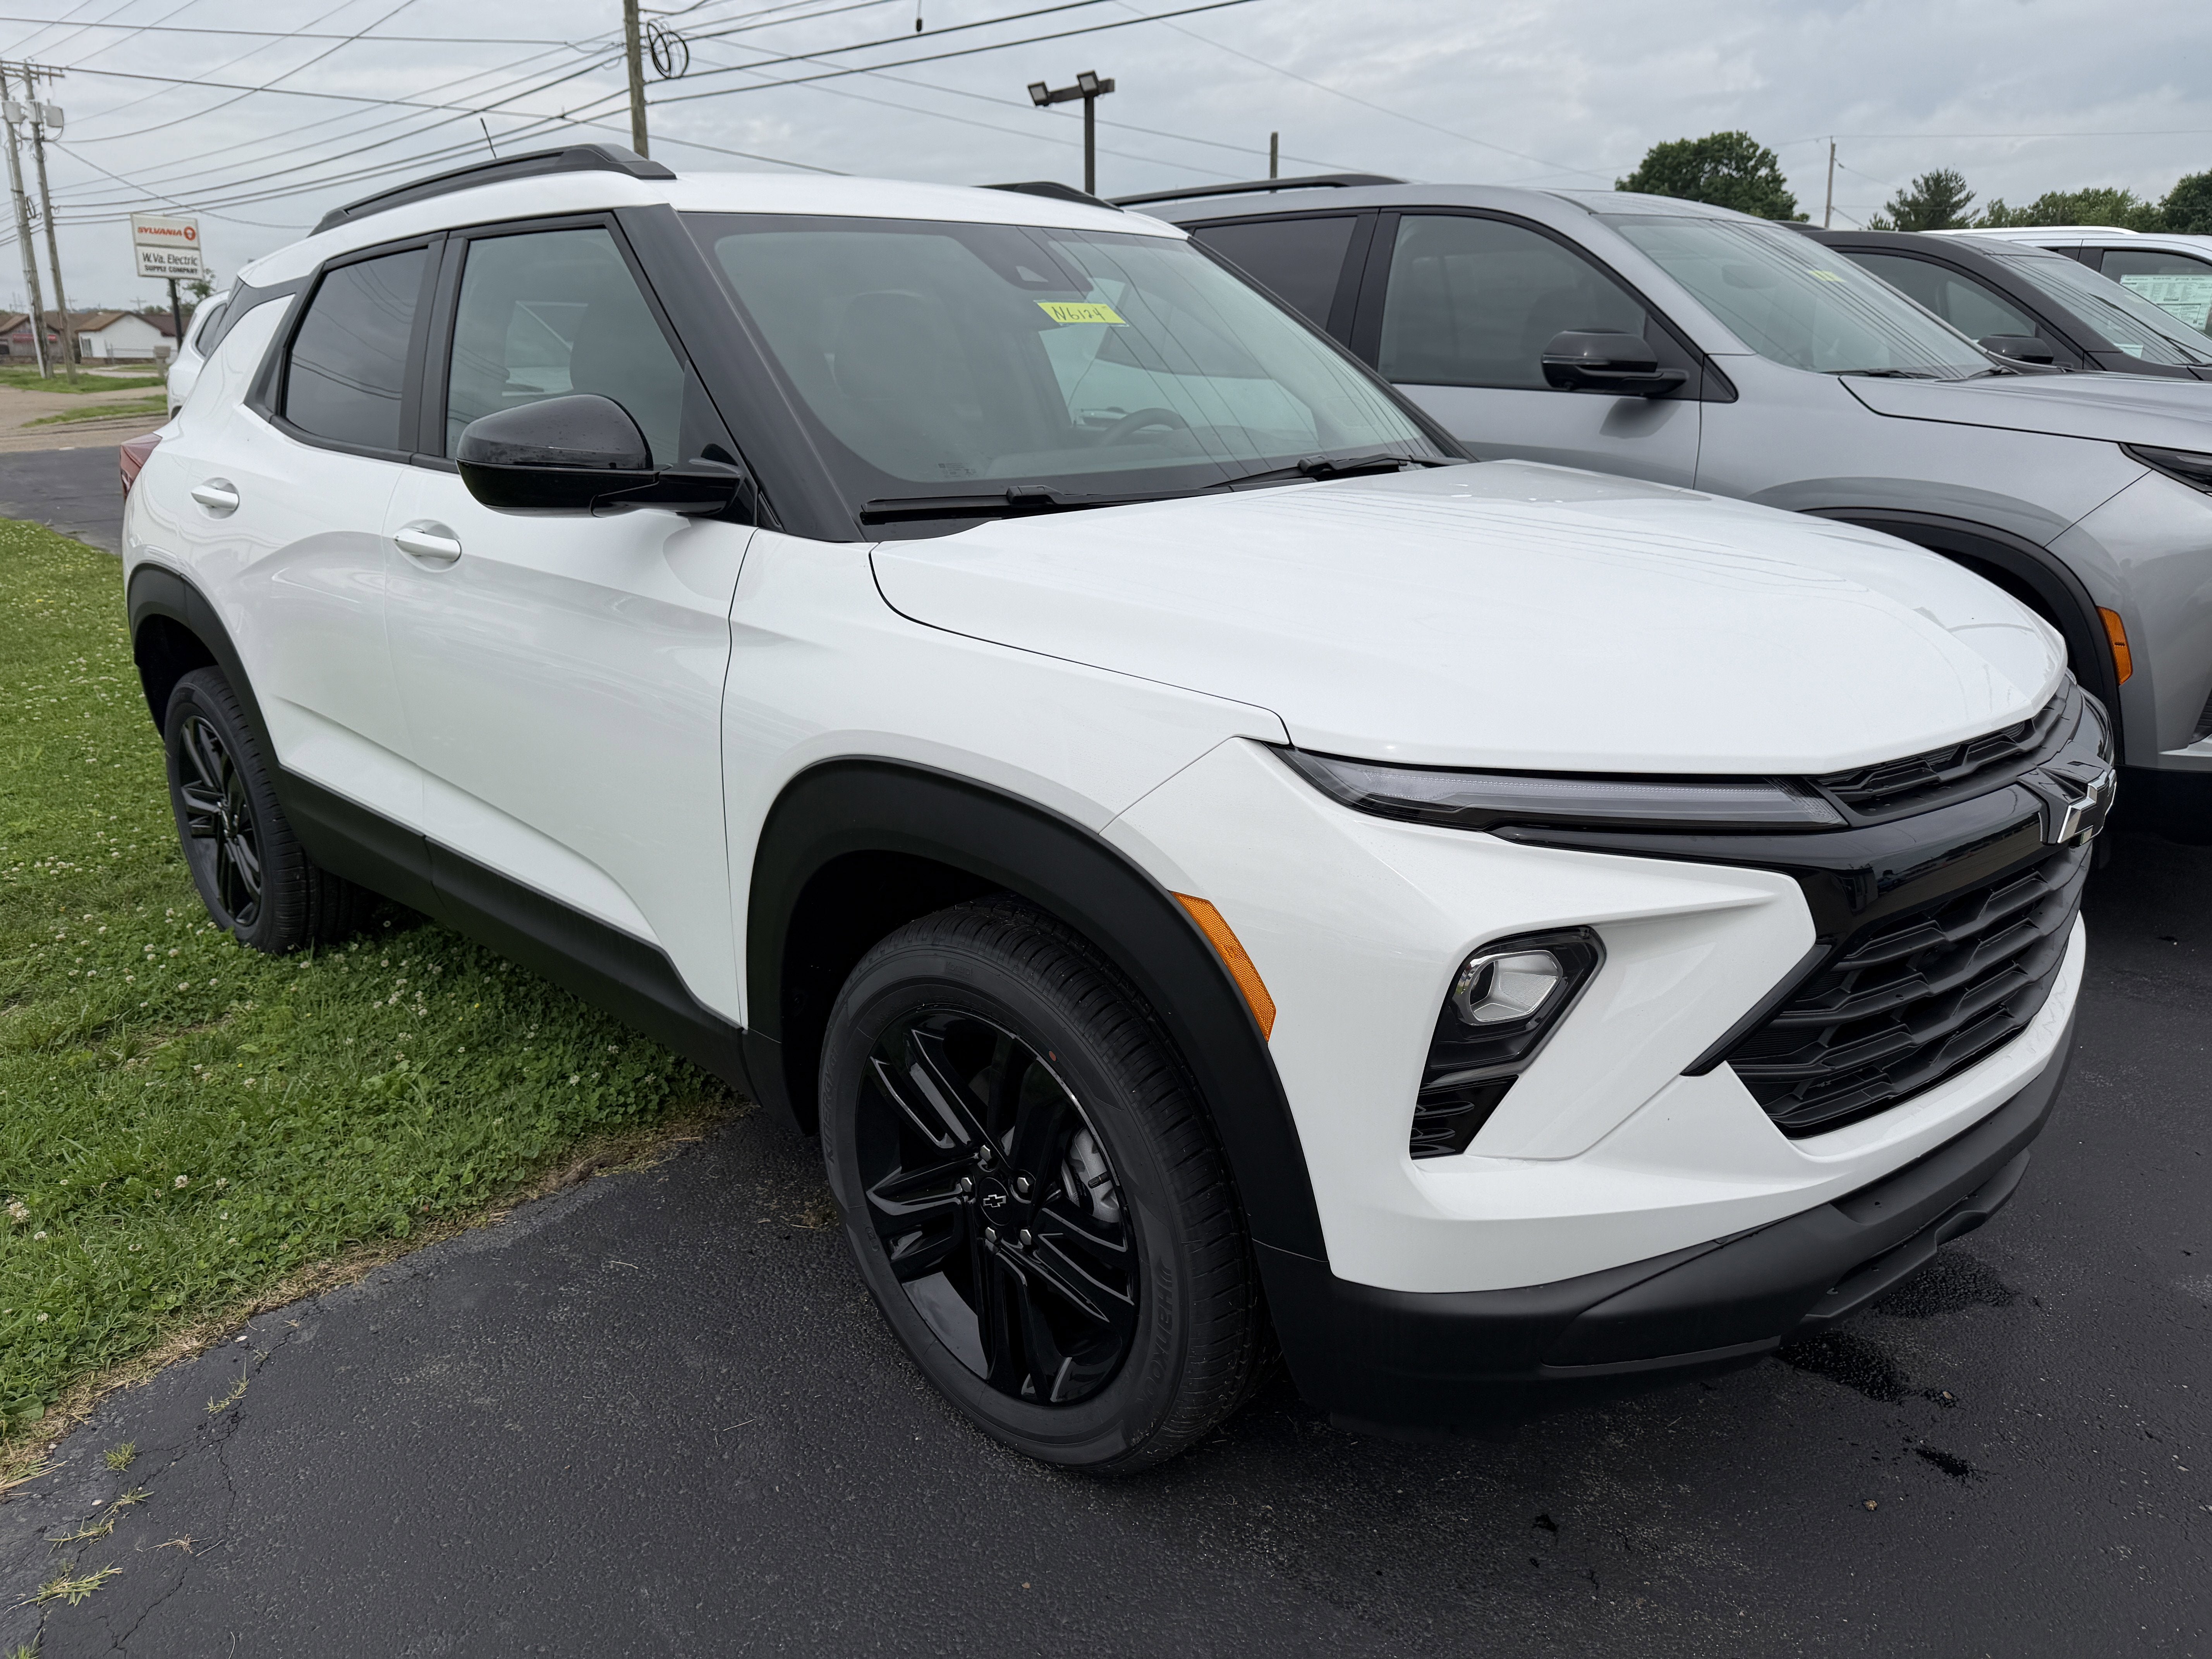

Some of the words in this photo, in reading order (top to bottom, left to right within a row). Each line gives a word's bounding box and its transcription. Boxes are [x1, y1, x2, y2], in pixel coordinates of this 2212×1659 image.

[137, 226, 182, 236] SYLVANIA
[167, 253, 198, 266] Electric
[168, 266, 197, 274] COMPANY
[1052, 306, 1106, 321] N6124
